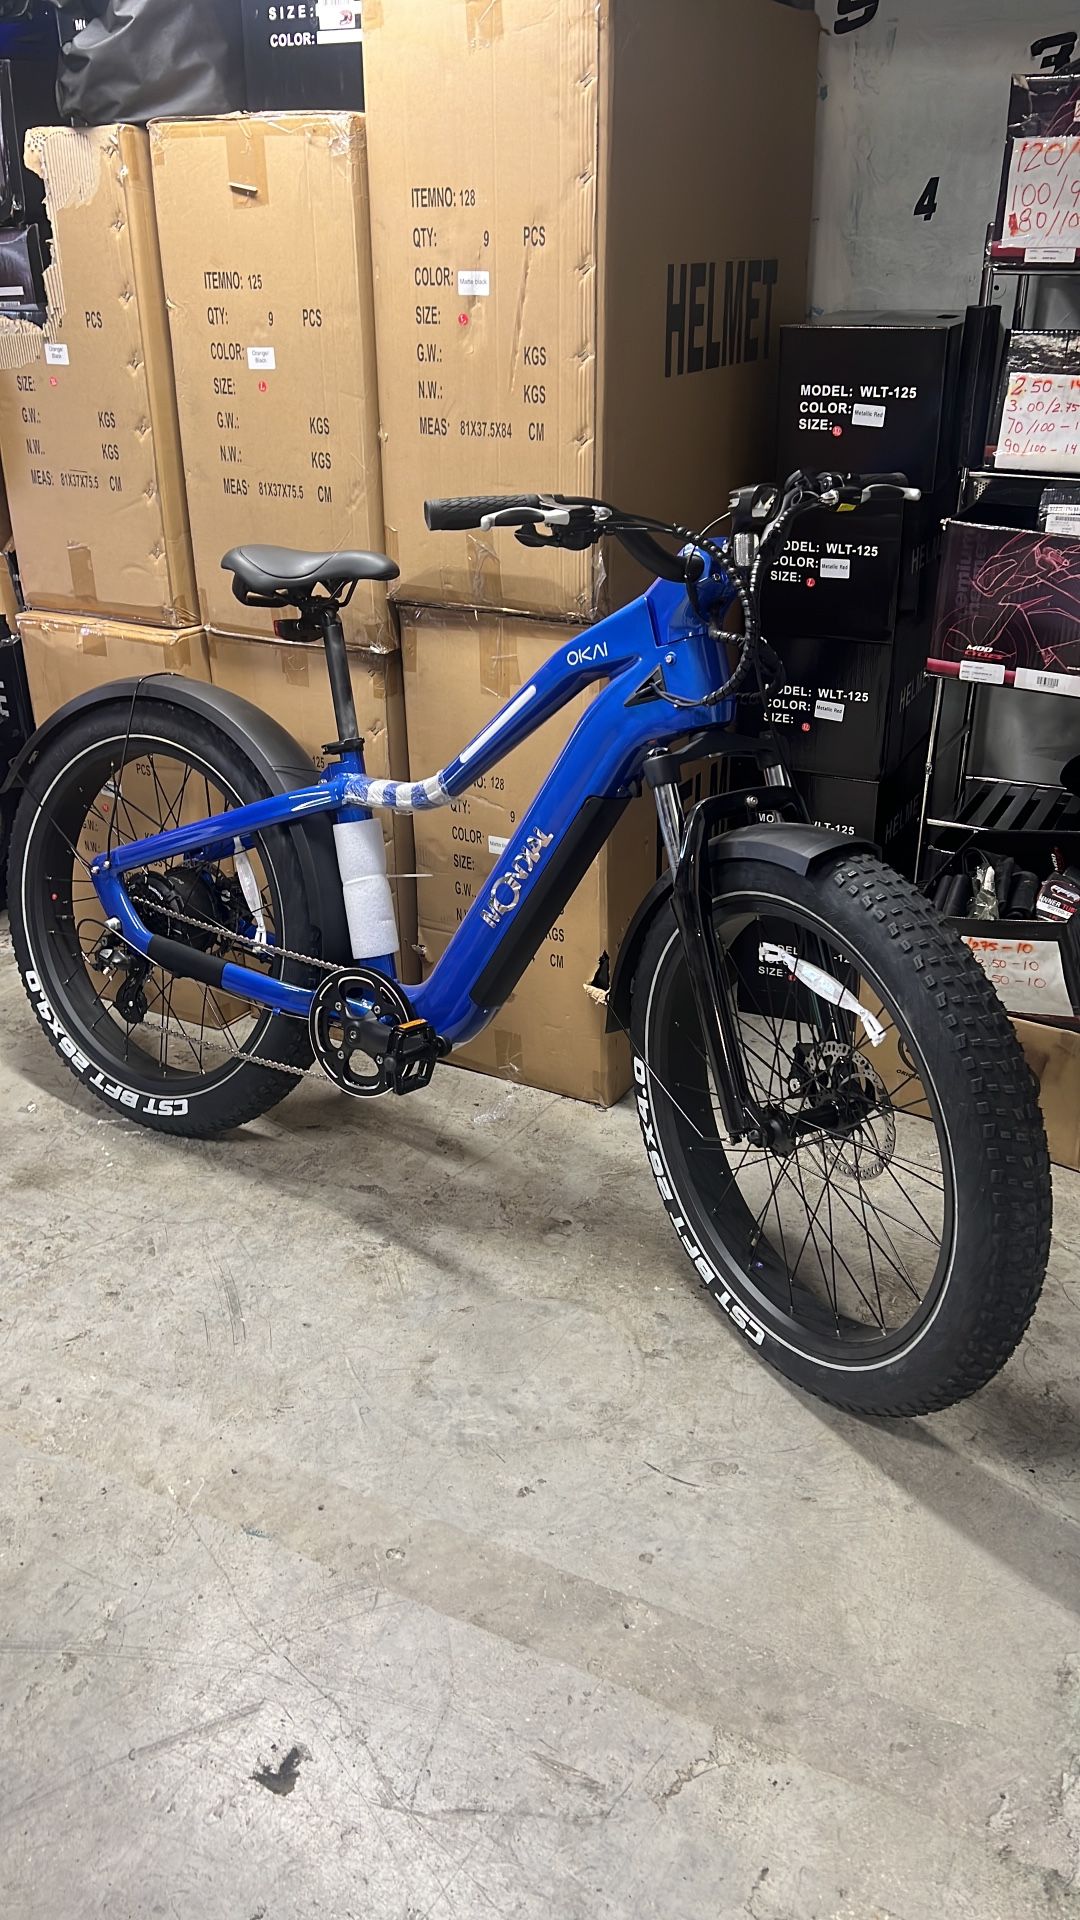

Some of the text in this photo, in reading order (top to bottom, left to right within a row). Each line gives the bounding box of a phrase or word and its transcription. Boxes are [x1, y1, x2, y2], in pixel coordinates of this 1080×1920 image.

[268, 5, 314, 20] SIZE:
[270, 32, 315, 47] COLOR:
[411, 187, 476, 208] ITEMNO: 128
[913, 176, 940, 222] 4
[412, 226, 546, 248] QTY: 9 PCS
[203, 271, 263, 290] ITEMNO: 125
[414, 267, 454, 286] COLOR:
[85, 311, 103, 329] PCS
[207, 307, 322, 328] QTY: 9 PCS
[415, 306, 441, 325] SIZE:
[664, 259, 779, 378] HELMET
[210, 342, 245, 361] COLOR:
[416, 344, 547, 366] G.W.: KGS
[17, 375, 36, 392] SIZE:
[213, 378, 236, 396] SIZE:
[418, 380, 546, 404] N.W.: KGS
[800, 384, 917, 399] MODEL: WLT-125
[799, 401, 852, 415] COLOR:
[98, 411, 116, 429] KGS
[217, 411, 330, 435] G.W.: KGS
[798, 419, 833, 431] SIZE:
[1007, 417, 1055, 435] 70/100
[460, 420, 512, 439] 81X37.5X84
[528, 422, 545, 441] CM
[101, 443, 120, 461] KGS
[1004, 438, 1047, 457] 90/100
[220, 445, 332, 470] N.W.: KGS
[31, 469, 123, 492] MEAS: 81X37X75.5 CM
[258, 482, 304, 500] 81X37X75.5
[317, 486, 332, 503] CM
[825, 542, 878, 557] WLT-125
[772, 556, 819, 569] OLOR:
[770, 570, 802, 583] SIZE:
[566, 641, 608, 666] OKAI
[817, 687, 869, 702] WLT-125
[135, 763, 151, 777] PCS
[312, 755, 325, 769] 125
[490, 777, 505, 791] 128
[510, 810, 516, 823] 9
[451, 826, 485, 844] COLOR:
[453, 854, 475, 871] SIZE:
[481, 826, 554, 929] MONDIAL
[1017, 942, 1033, 954] 10
[549, 954, 564, 969] CM
[1023, 960, 1039, 971] 10
[1028, 977, 1047, 988] 10
[89, 1072, 140, 1109] BFT
[142, 1098, 189, 1116] CST
[669, 1211, 716, 1285] BFT
[714, 1290, 766, 1346] CST
